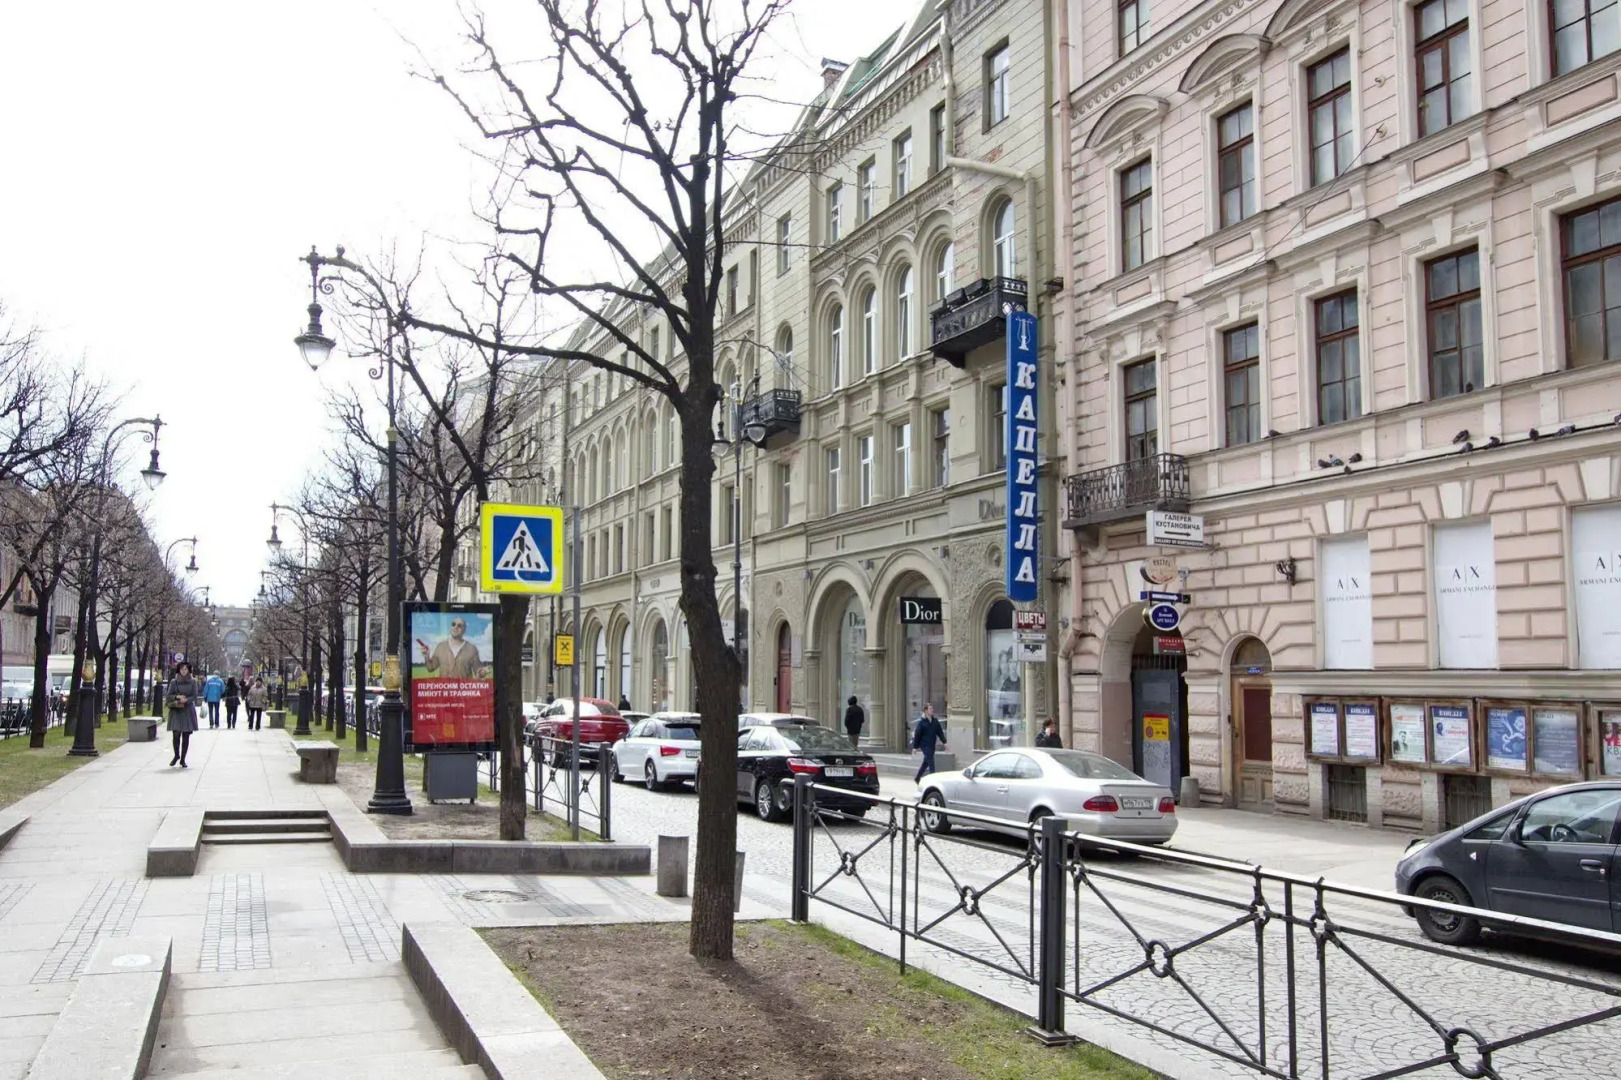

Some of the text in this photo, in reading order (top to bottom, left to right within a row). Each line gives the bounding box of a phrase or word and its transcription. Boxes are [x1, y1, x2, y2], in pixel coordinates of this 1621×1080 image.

[1014, 361, 1036, 583] КАПЕЛЛА
[1164, 514, 1192, 522] ГАЛЕРЕЯ
[1155, 521, 1201, 530] КУСТАНОВИЧА
[1580, 578, 1607, 586] ARMANI
[904, 600, 940, 621] Dior
[1018, 612, 1046, 625] ЦВЕТЫ
